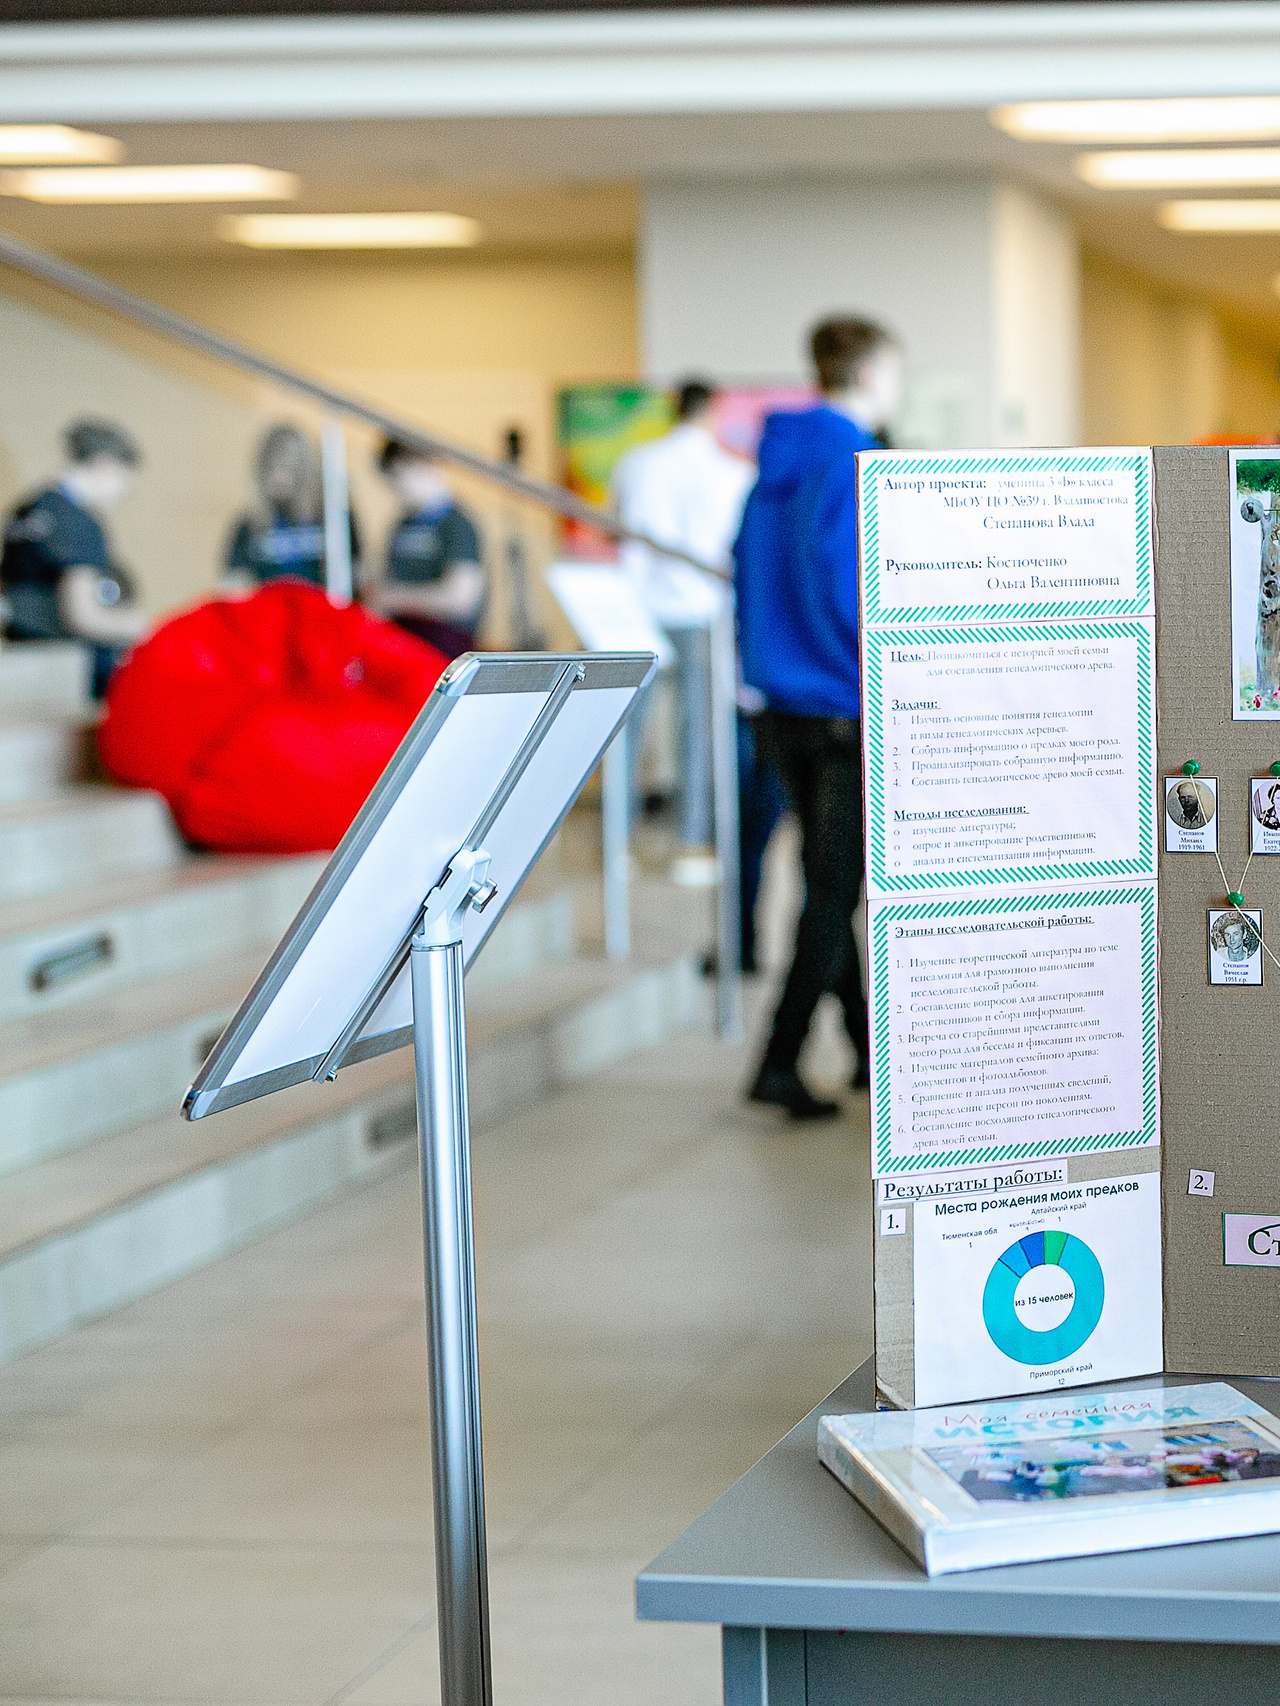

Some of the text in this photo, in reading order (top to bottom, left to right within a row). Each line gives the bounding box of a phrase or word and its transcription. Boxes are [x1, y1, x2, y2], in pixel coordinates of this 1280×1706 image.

[884, 478, 925, 493] Автор
[929, 480, 986, 491] проекта:
[943, 496, 983, 508] МБОУ
[1054, 495, 1128, 506] Владивостока
[983, 515, 1095, 530] Степанова Влада
[886, 556, 1067, 574] Руководитель: Костюченко
[987, 575, 1120, 590] Ольга Валентиновна
[891, 652, 925, 663] Цель:
[892, 699, 938, 711] Задачи:
[911, 714, 951, 726] Изучить
[954, 714, 999, 723] основные
[1002, 712, 1040, 720] понятия
[911, 740, 1066, 756] Собрать информацию предках
[912, 759, 1001, 773] Проанализировать
[1004, 756, 1056, 768] собранную
[911, 776, 960, 787] Составить
[894, 805, 1026, 821] Методы исследования:
[912, 826, 956, 836] изучение
[912, 841, 942, 852] опрос
[953, 836, 1023, 848] анкетирование
[913, 857, 945, 866] анализ
[957, 852, 1030, 863] систематизация
[895, 915, 1092, 938] Этапы исследовательской работы:
[910, 947, 1082, 969] Изучение теоретической литературы
[911, 973, 962, 983] генеалогия
[983, 966, 1037, 977] грамотного
[911, 980, 1038, 998] исследовательской работы.
[910, 989, 1104, 1013] Составление вопросов анкетирования
[911, 1015, 982, 1030] родственников
[994, 1009, 1021, 1020] сбора
[908, 1019, 1100, 1045] Встреча старейшими представителями
[939, 1031, 1124, 1057] рода беседы фиксации ответов.
[911, 1050, 1064, 1074] Изучение материалов семейного
[912, 1076, 967, 1089] документов
[911, 1080, 1065, 1104] Сравнение анализ полученных
[912, 1105, 983, 1120] распределение
[986, 1101, 1018, 1114] персон
[912, 1121, 972, 1133] Составление
[975, 1115, 1035, 1128] восходящего
[967, 1134, 998, 1143] семьи.
[884, 1166, 1063, 1201] Результаты работы:
[1194, 1174, 1209, 1190] 2.
[935, 1181, 1139, 1216] Места рождения моих предков
[1031, 1202, 1086, 1215] Алтайский край
[886, 1214, 899, 1230] 1.
[942, 1231, 982, 1241] Тюменская
[1015, 1291, 1073, 1307] из 15 человек
[1030, 1363, 1093, 1379] Приморский край
[933, 1406, 1199, 1439] ИСТОРИЯ
[944, 1402, 1152, 1427] Моя семейная
